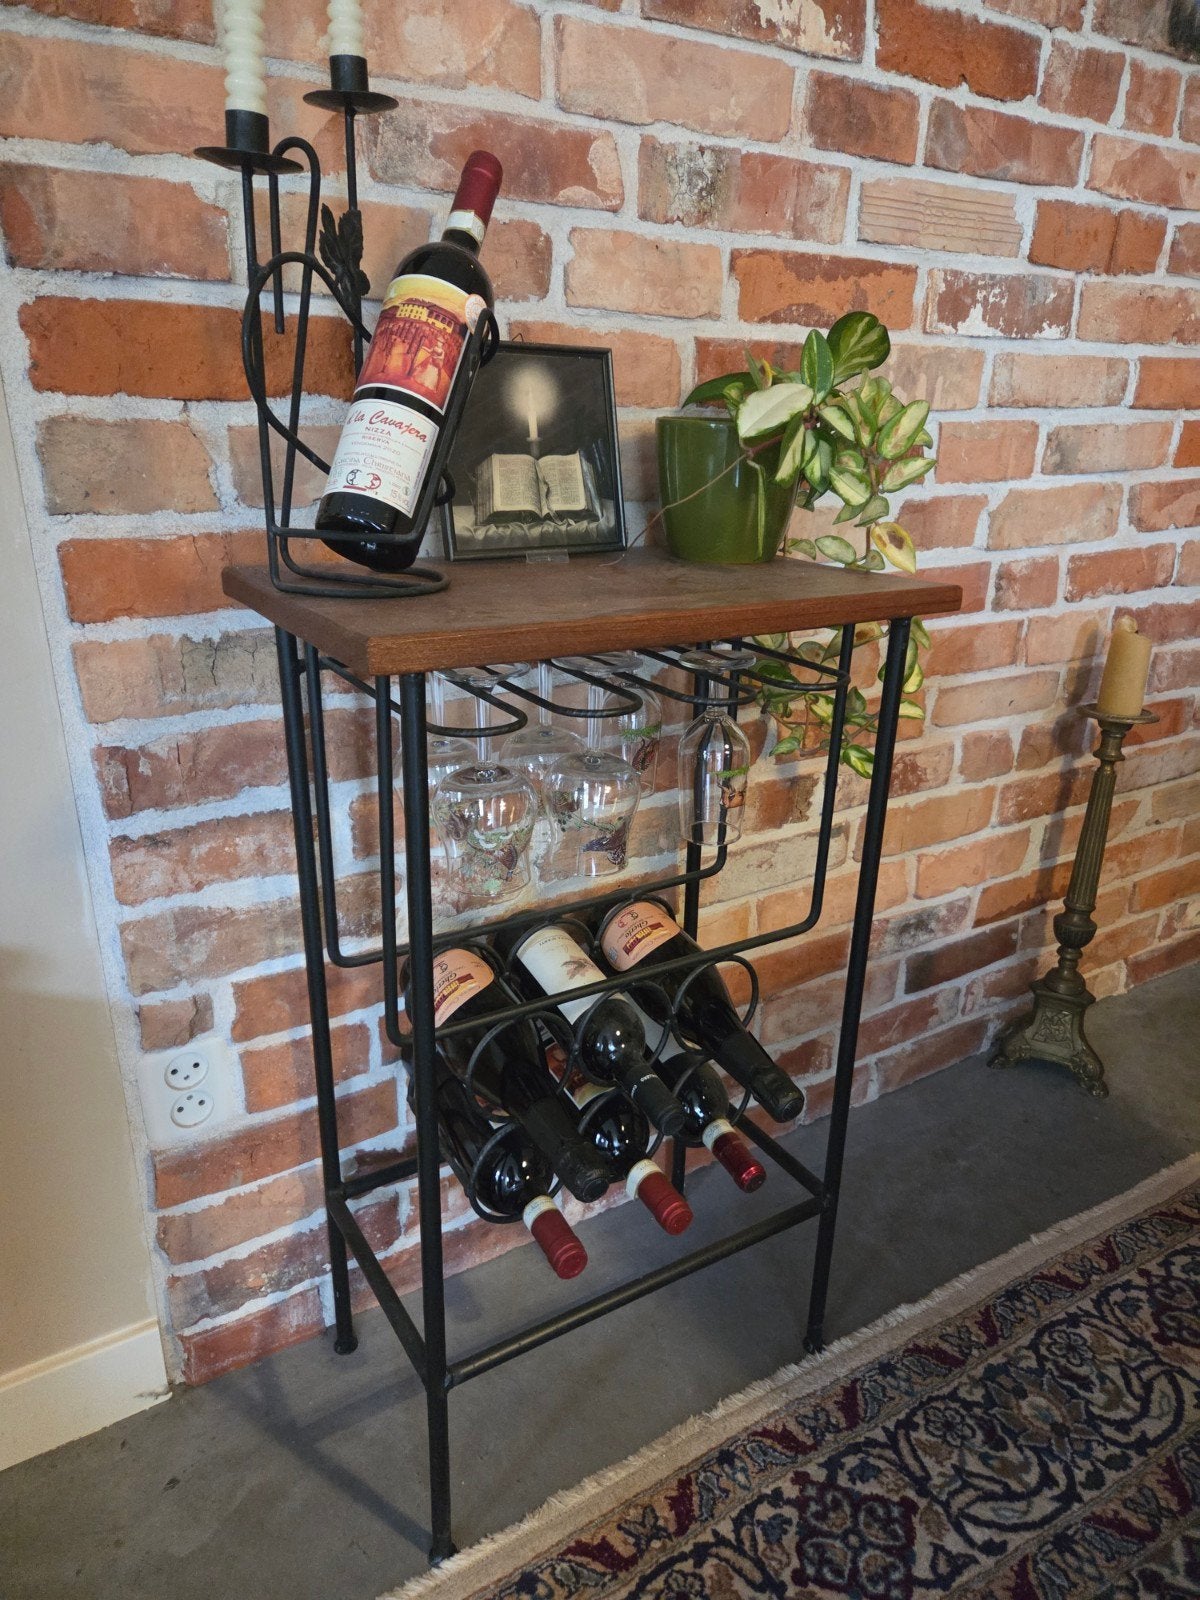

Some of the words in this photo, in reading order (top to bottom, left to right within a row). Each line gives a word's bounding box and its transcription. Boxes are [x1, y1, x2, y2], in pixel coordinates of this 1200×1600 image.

[364, 425, 392, 437] NIZZA
[369, 410, 428, 442] Cavajera
[361, 435, 390, 445] RISERVA
